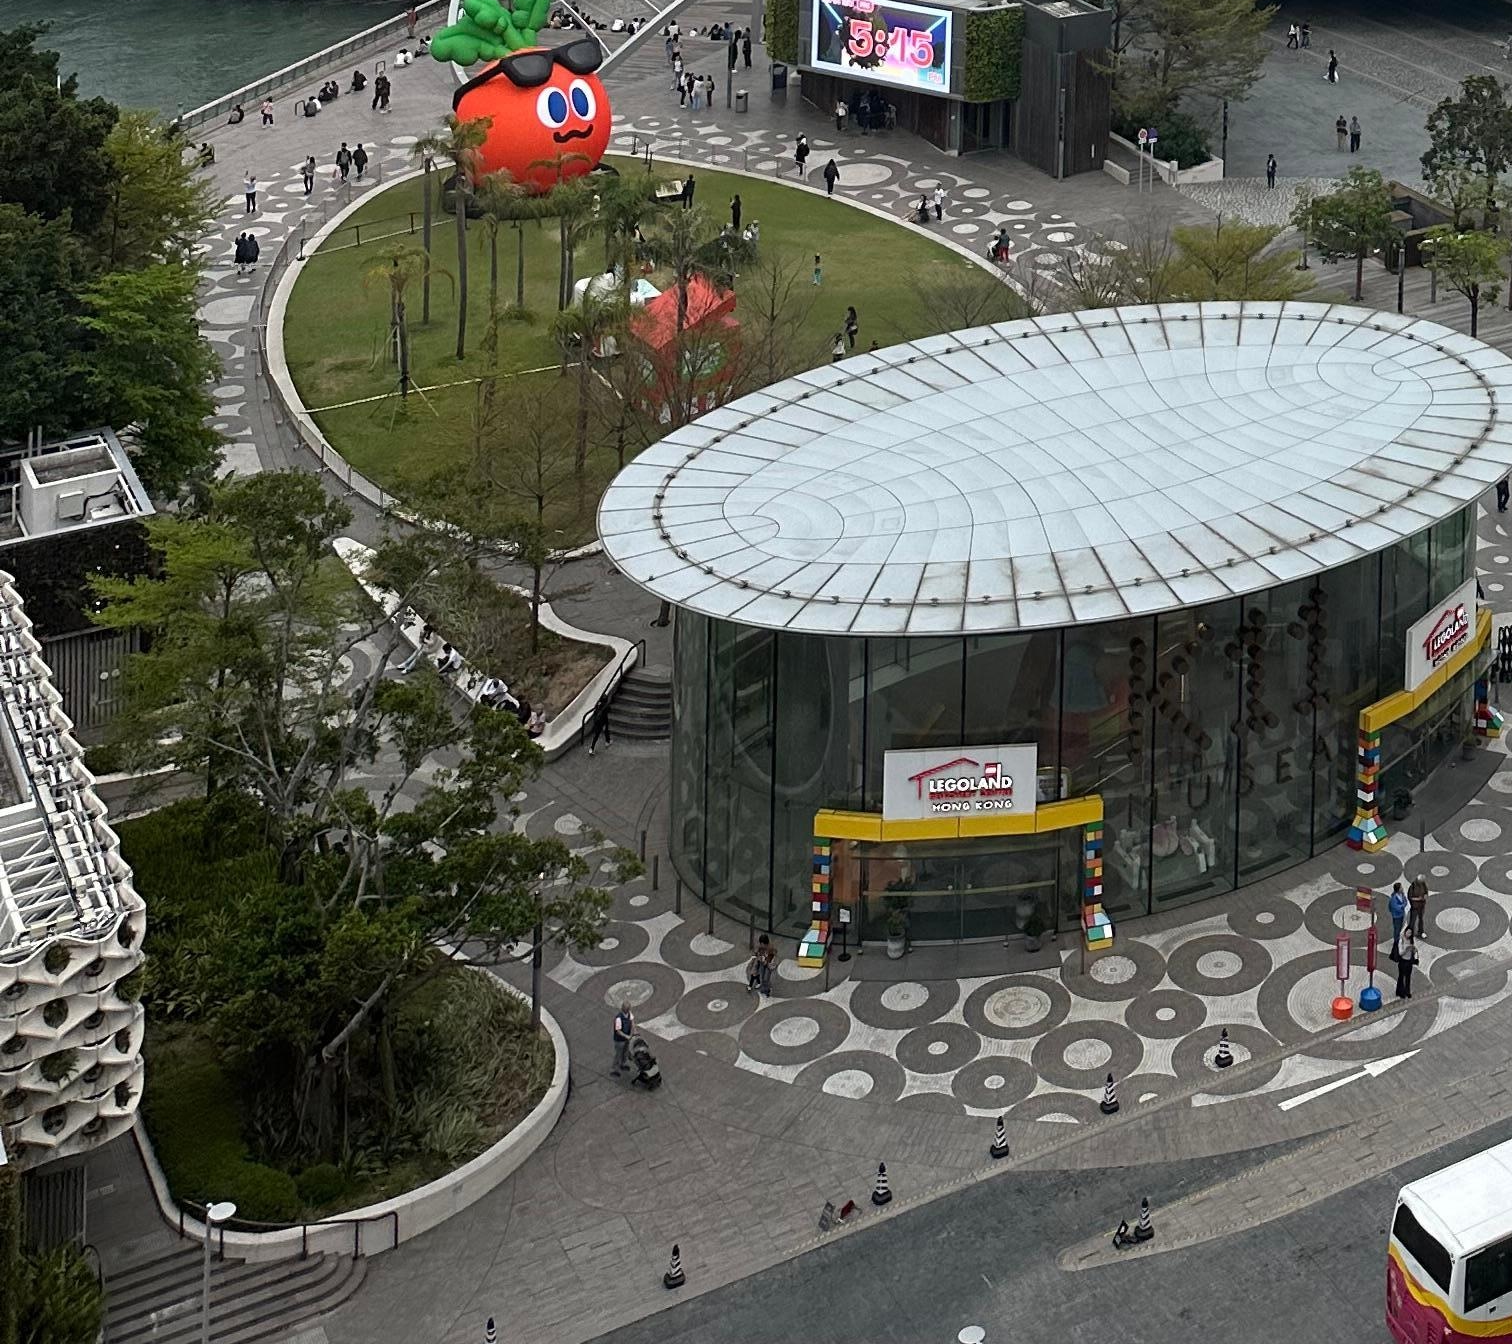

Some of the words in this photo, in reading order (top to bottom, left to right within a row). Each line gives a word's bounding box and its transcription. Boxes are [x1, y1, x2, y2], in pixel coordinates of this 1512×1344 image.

[848, 18, 934, 69] 5:15
[928, 772, 1013, 793] LEGOLAND
[932, 801, 970, 812] HONG
[975, 798, 1013, 810] KONG
